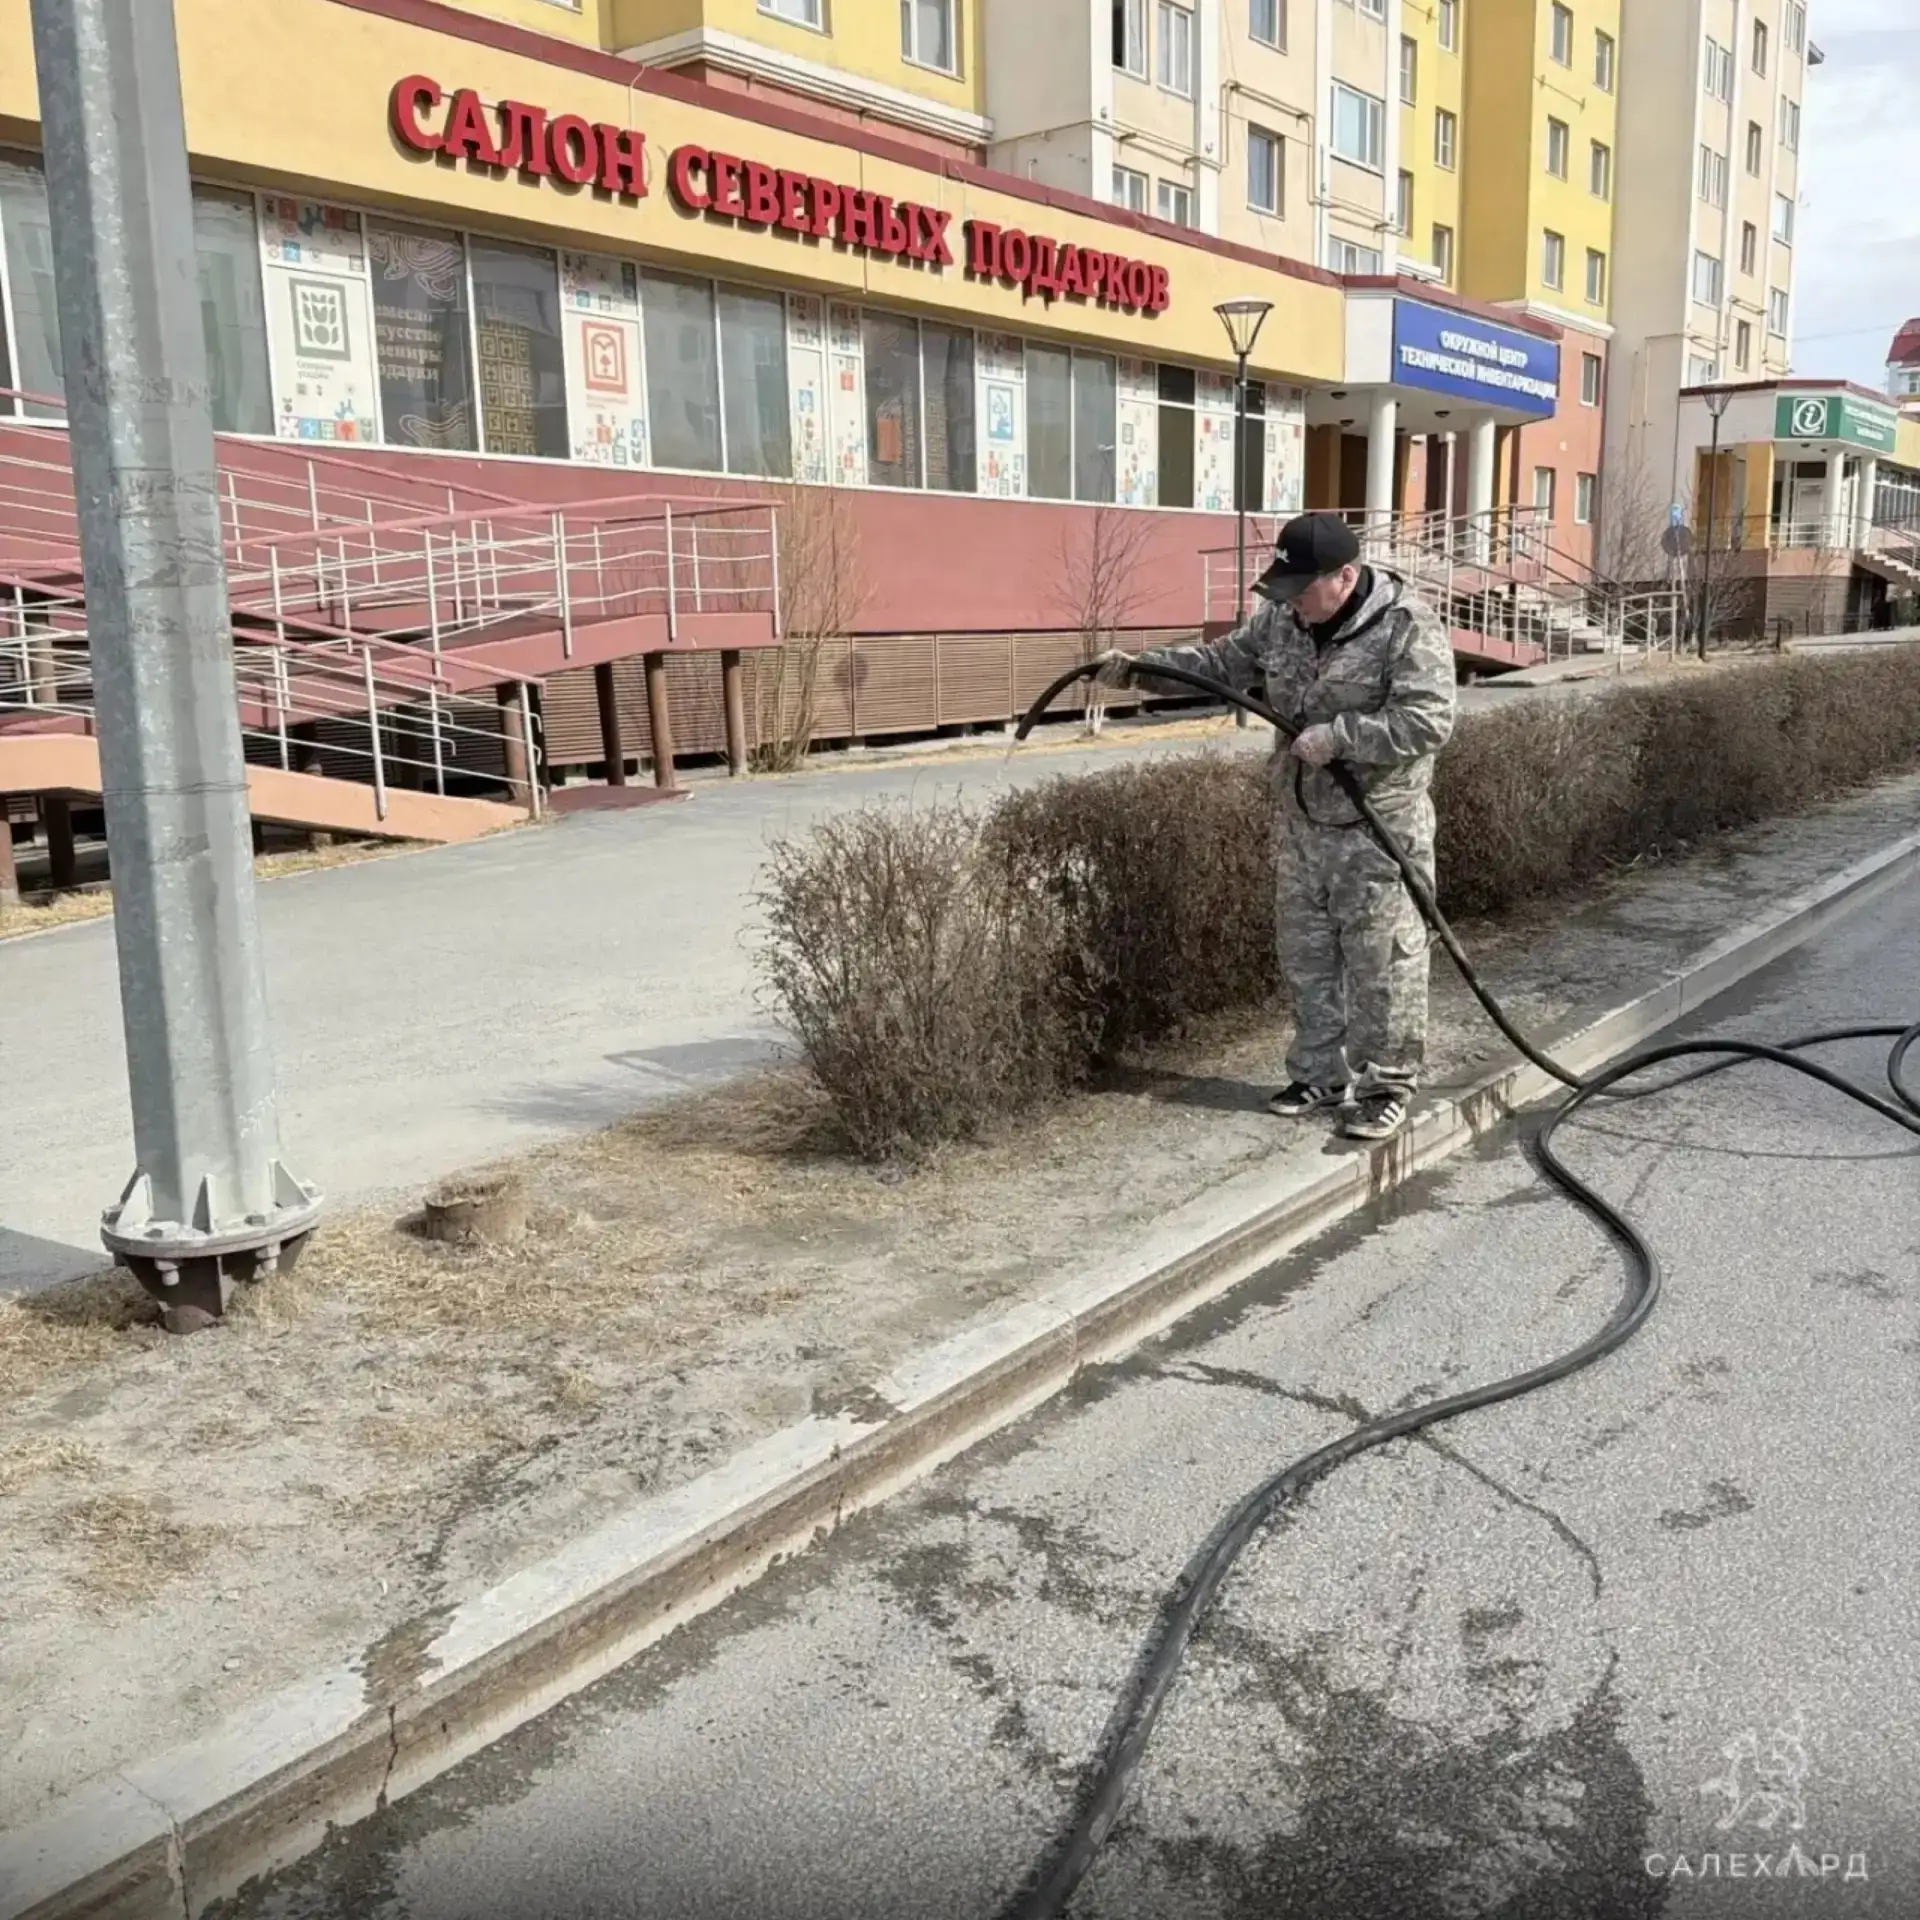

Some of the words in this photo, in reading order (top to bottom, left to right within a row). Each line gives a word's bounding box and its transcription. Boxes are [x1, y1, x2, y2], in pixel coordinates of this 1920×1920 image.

[390, 75, 648, 197] САЛОН
[668, 144, 954, 265] СЕВЕРНЫХ
[966, 219, 1170, 312] ПОДАРКОВ
[1401, 345, 1475, 380] ТЕХНИЧЕСКОЙ
[1476, 364, 1557, 400] ИНВЕНТАРИЗАЦИИ
[1440, 331, 1498, 361] ОКРУЖНОЙ
[1498, 346, 1529, 369] ЦЕНТР
